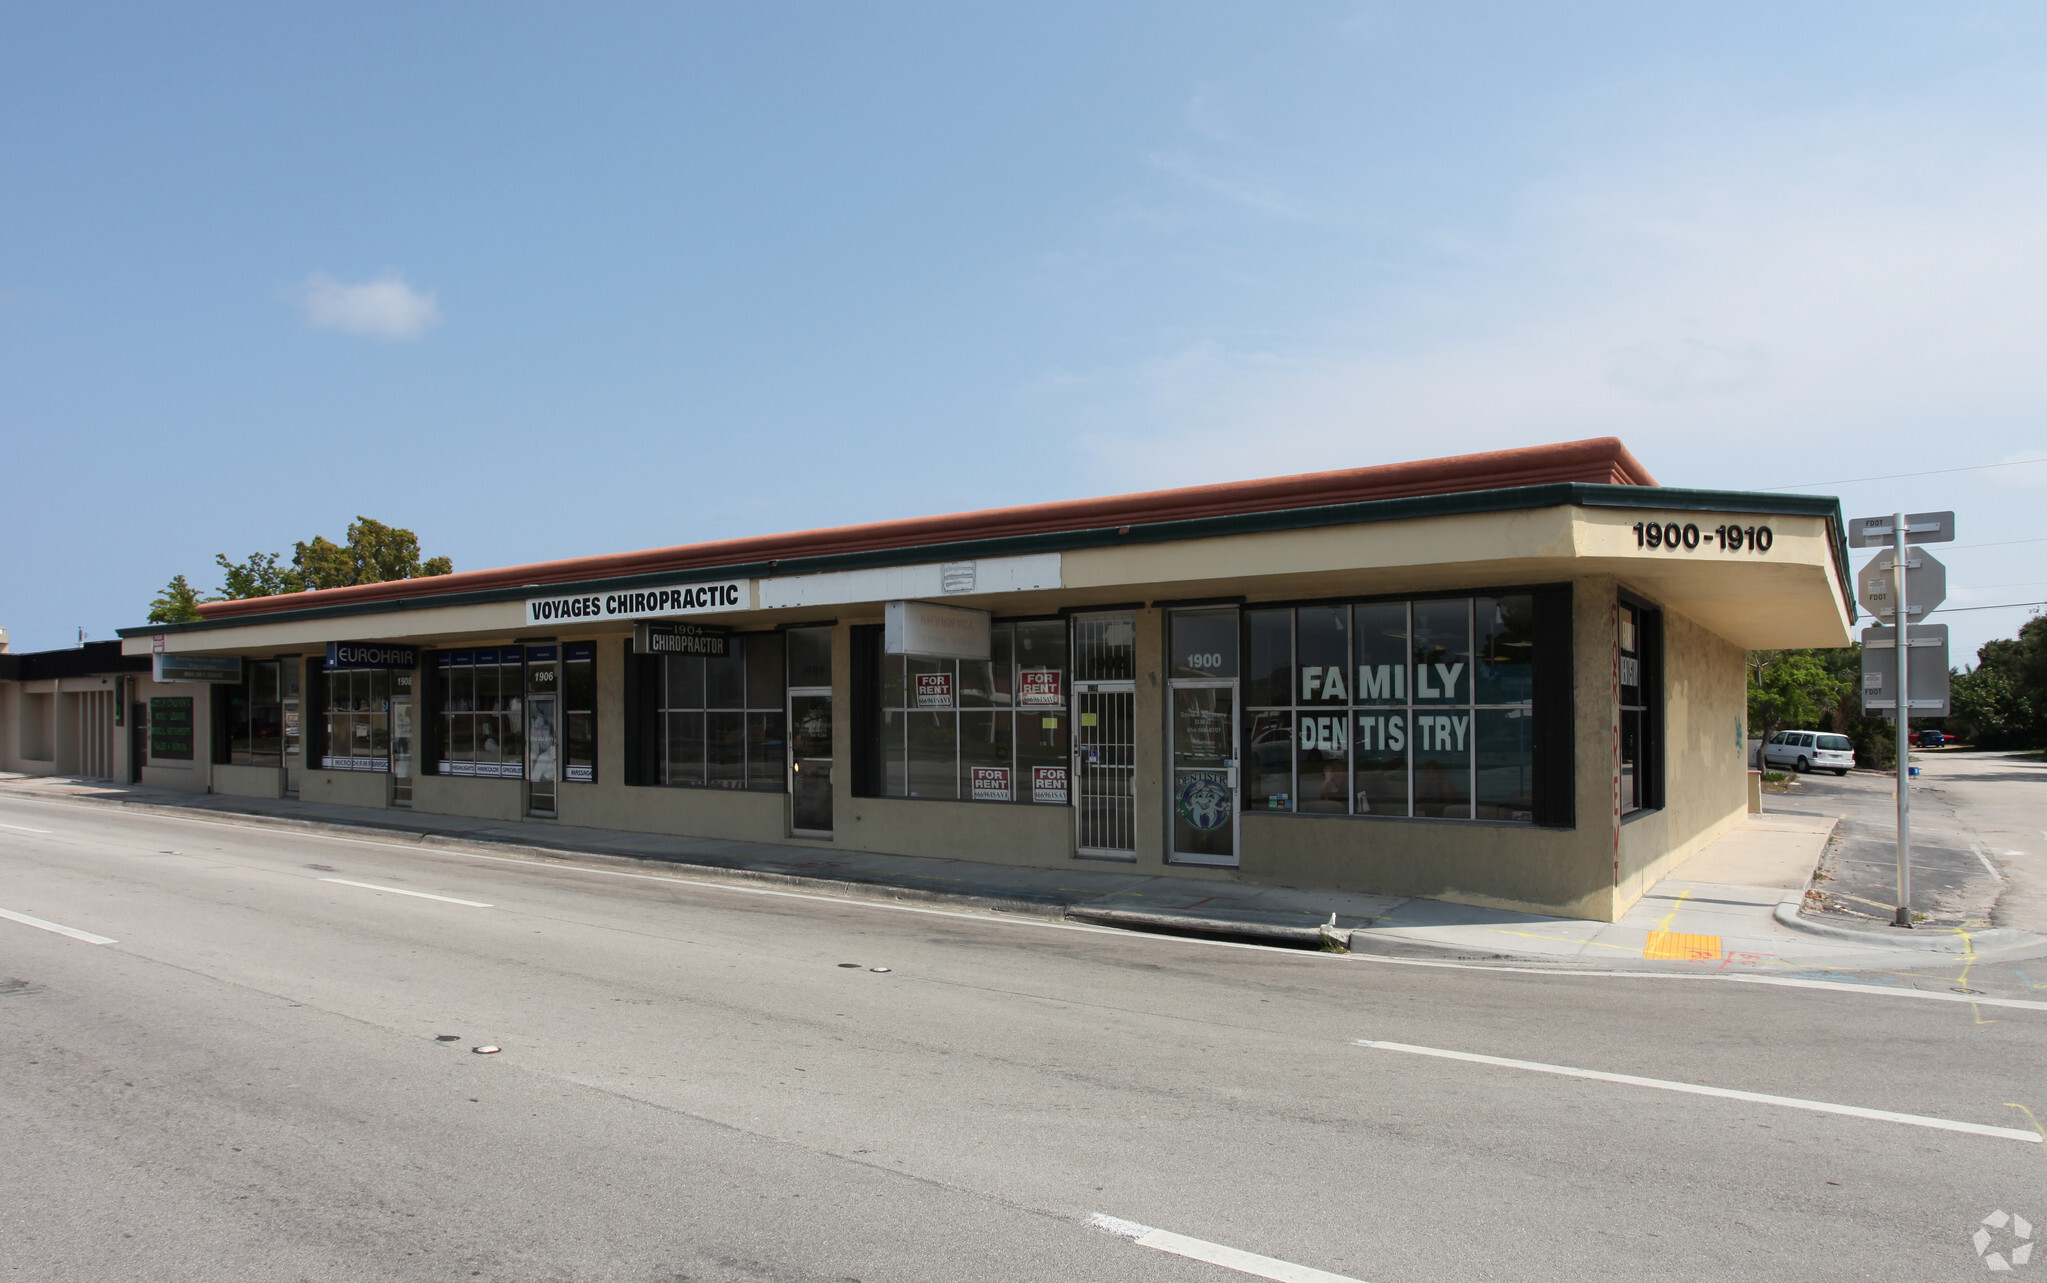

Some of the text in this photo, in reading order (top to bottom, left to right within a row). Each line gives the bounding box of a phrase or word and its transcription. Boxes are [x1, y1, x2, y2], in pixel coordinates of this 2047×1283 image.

[1865, 519, 1884, 527] FDOT
[1633, 521, 1773, 551] 1900-1910
[532, 584, 739, 620] VOYAGES CHIROPRACTIC
[1869, 593, 1887, 601] FDOT
[674, 625, 704, 636] 1904
[652, 634, 724, 654] CHIROPRACTOR
[338, 647, 413, 665] EUROHAIR
[1187, 653, 1222, 668] 1900
[534, 670, 555, 683] 1906
[922, 676, 945, 686] FOR
[1027, 673, 1053, 683] FOR
[919, 685, 949, 695] RENT
[1023, 683, 1057, 693] RENT
[1087, 684, 1099, 692] 1902
[1864, 687, 1883, 696] FDOT
[978, 770, 1003, 779] FOR
[1039, 769, 1066, 779] FOR
[975, 779, 1007, 789] RENT
[1035, 778, 1068, 789] RENT
